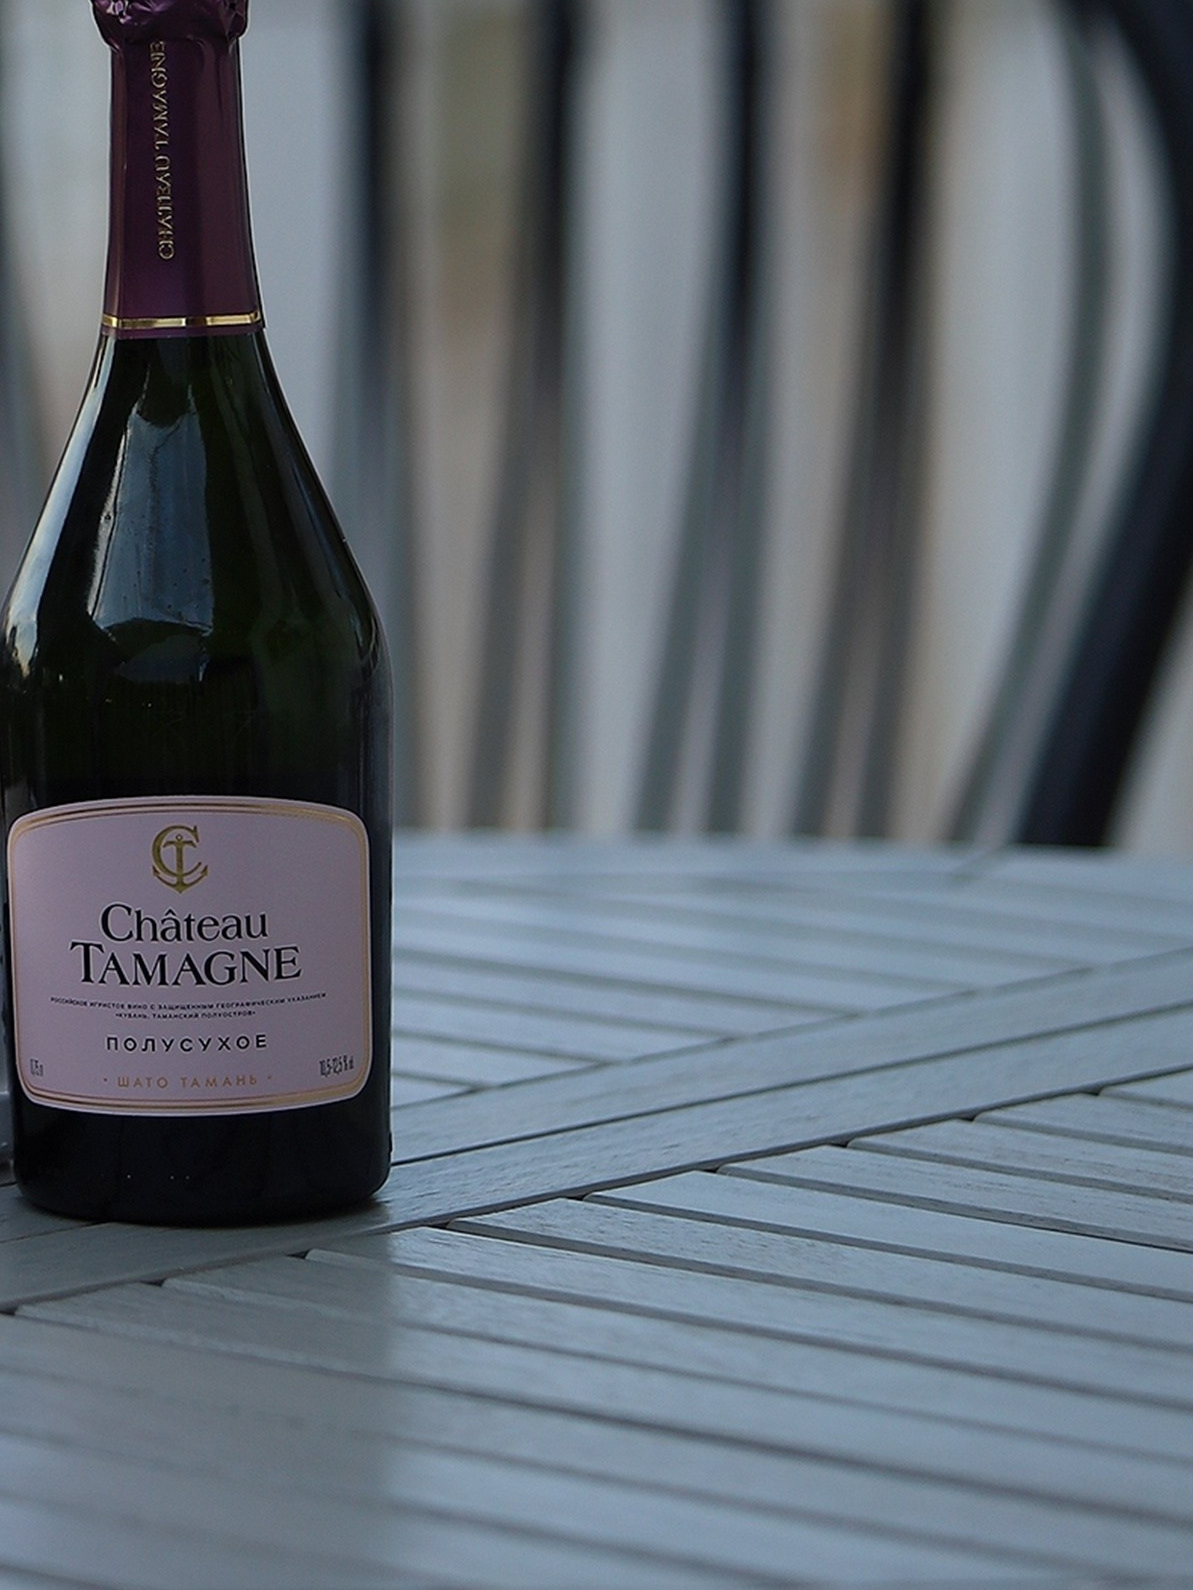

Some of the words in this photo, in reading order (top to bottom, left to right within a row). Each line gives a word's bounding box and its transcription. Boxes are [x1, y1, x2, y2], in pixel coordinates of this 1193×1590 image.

[150, 40, 170, 150] TAMAGNE
[154, 155, 175, 260] CHATEAU
[100, 903, 268, 942] Château
[69, 941, 302, 986] TAMAGNE
[89, 1002, 125, 1010] ИГРИСТОЕ
[106, 1034, 267, 1052] ПОЛУСУХОЕ
[117, 1077, 168, 1089] ШАТО
[180, 1074, 257, 1089] ТАМАНЬ
